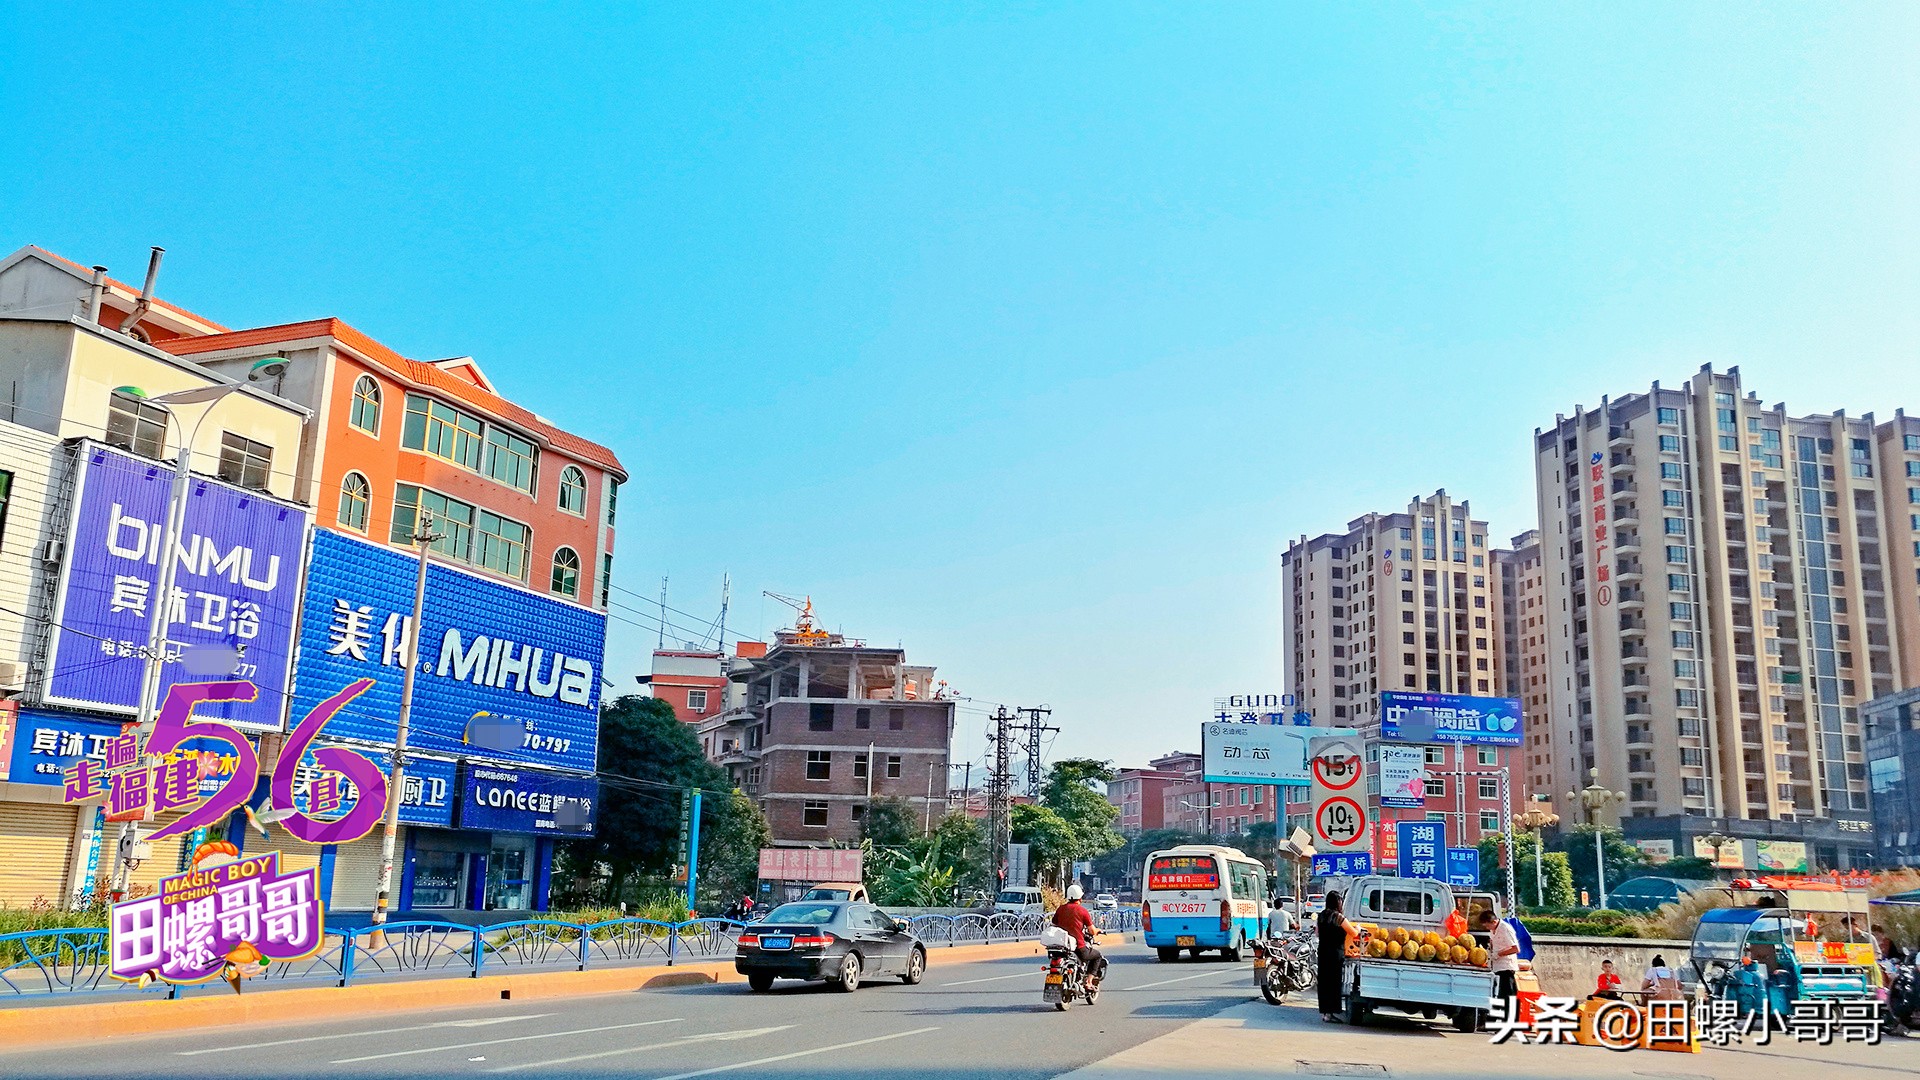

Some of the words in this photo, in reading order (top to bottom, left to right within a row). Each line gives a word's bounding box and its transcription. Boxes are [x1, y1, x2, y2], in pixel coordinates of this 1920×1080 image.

[1591, 464, 1610, 582] 联盟商业广场
[326, 598, 421, 670] 美化
[1386, 704, 1481, 731] 中阀芯
[30, 728, 107, 761] 宾沐卫
[1328, 805, 1353, 824] 10t
[1410, 826, 1437, 880] 湖西新
[1450, 852, 1474, 861] 联盟村
[1162, 903, 1207, 913] 闽CY2677
